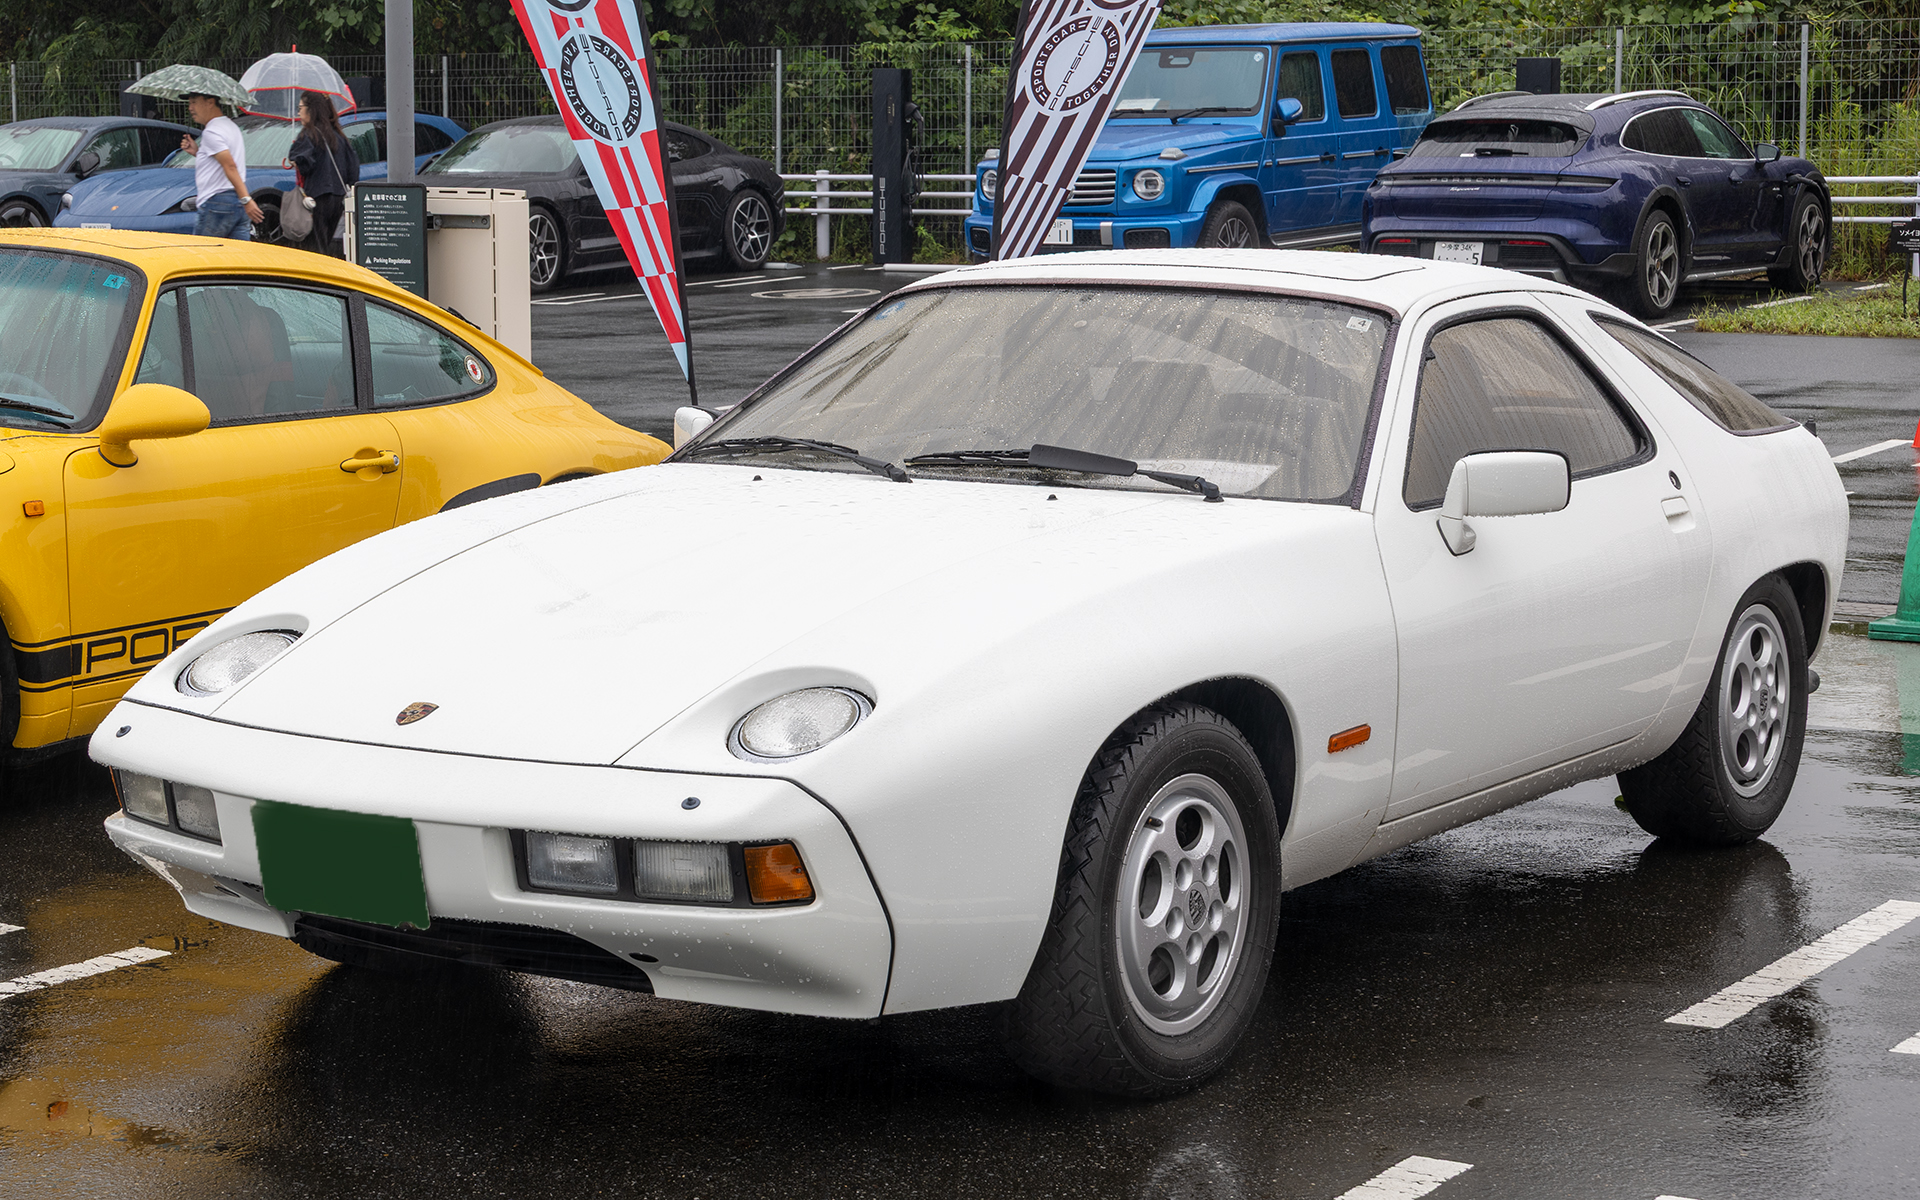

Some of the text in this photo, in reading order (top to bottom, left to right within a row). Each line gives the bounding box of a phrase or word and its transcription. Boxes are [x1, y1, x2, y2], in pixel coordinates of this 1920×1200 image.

[1033, 23, 1077, 93] SPORTSCAR
[1048, 15, 1104, 111] PORSCHE
[1066, 26, 1118, 108] TOGETHER DAY
[1472, 253, 1480, 265] 5
[86, 617, 219, 674] POR
